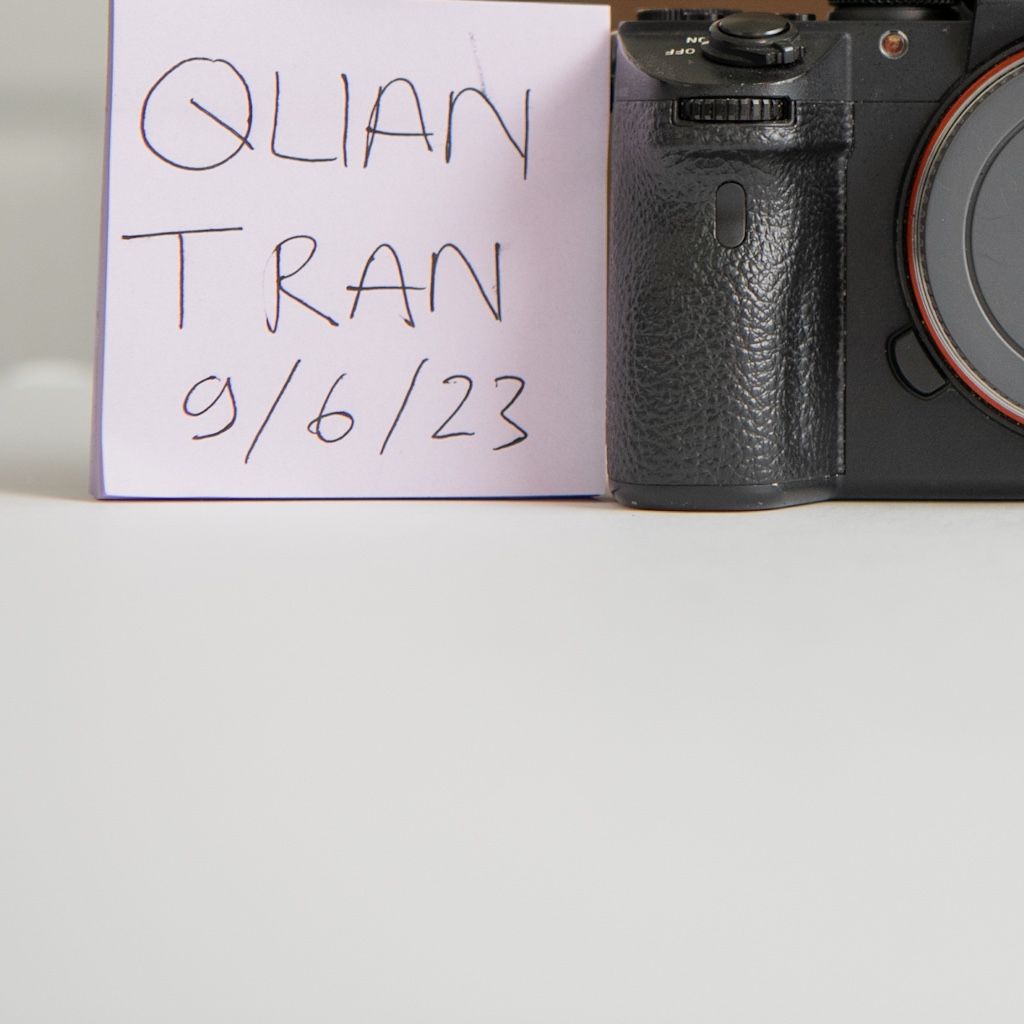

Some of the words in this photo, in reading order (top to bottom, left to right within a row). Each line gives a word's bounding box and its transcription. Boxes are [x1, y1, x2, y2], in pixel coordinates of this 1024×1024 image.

[664, 48, 696, 56] OFF
[121, 227, 503, 334] TRAN
[182, 357, 529, 465] 9/6/23
